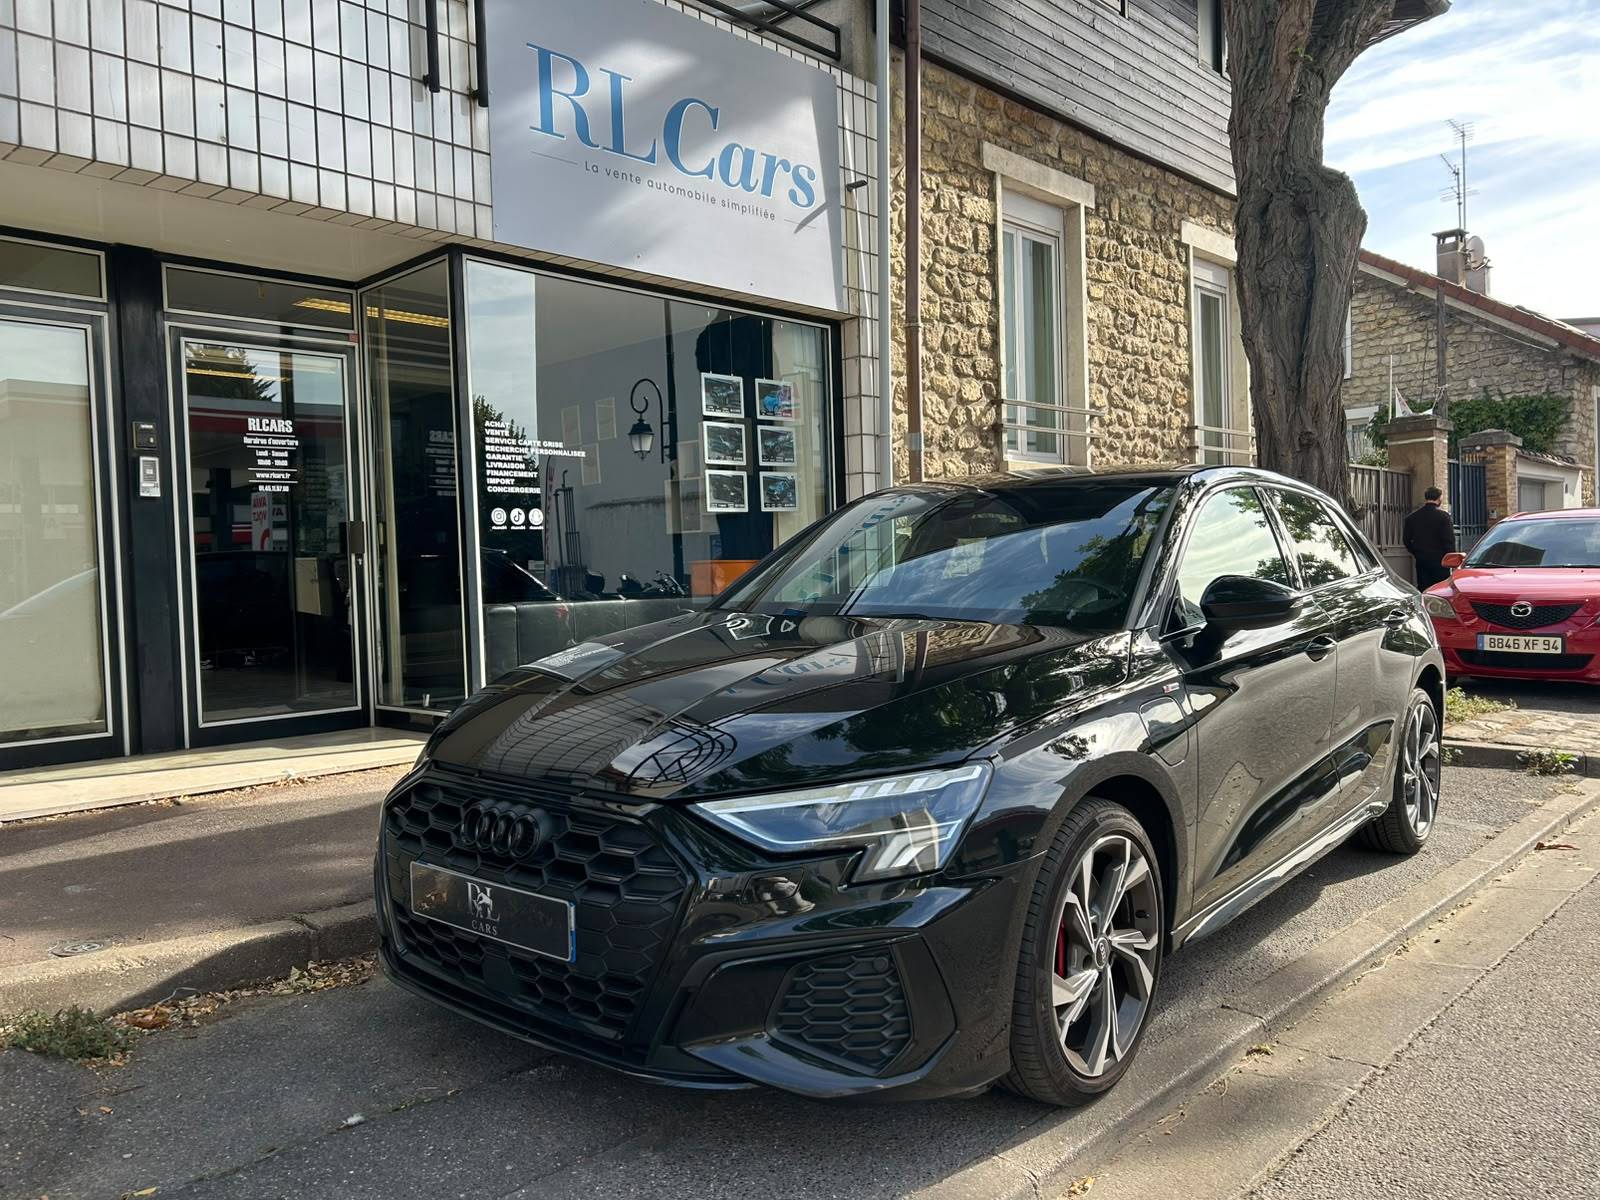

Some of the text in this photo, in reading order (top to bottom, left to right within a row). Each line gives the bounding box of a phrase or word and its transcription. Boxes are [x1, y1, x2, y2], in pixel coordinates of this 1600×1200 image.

[585, 160, 776, 220] La vente automobile simplifiée
[248, 418, 293, 432] RLCARS
[484, 420, 509, 429] ACHAT
[485, 428, 509, 437] VENTE
[243, 436, 267, 444] Horaires
[485, 437, 564, 449] SERVICE CARTE GRISE
[485, 445, 529, 454] RECHERCHE
[485, 453, 523, 462] GARANTIE
[486, 461, 525, 470] LIVRAISON
[486, 469, 538, 478] FINANCEMENT
[487, 478, 515, 486] IMPORT
[487, 485, 541, 494] CONCIERGERIE
[1488, 637, 1559, 651] 8846 XF 94
[471, 919, 498, 937] CARS
